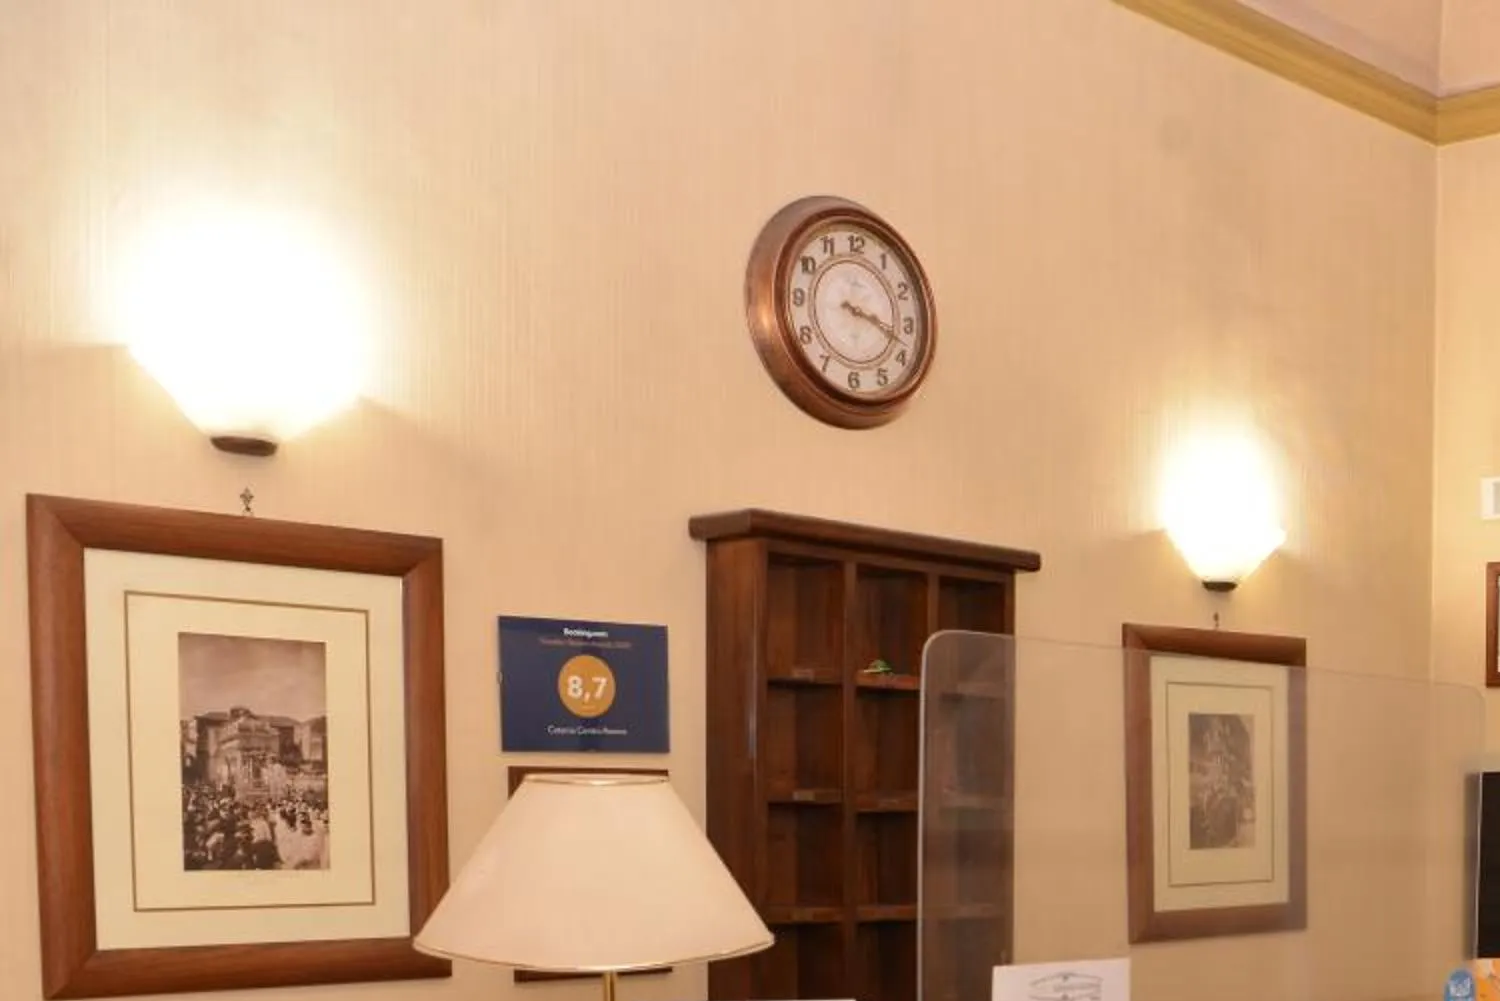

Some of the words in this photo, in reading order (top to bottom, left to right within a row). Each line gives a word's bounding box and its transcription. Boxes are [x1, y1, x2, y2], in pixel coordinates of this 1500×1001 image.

[820, 236, 835, 256] 11
[848, 235, 866, 254] 12
[801, 256, 817, 275] 10
[880, 254, 888, 269] 1
[792, 287, 806, 306] 9
[897, 282, 909, 300] 2
[800, 326, 813, 344] 8
[904, 317, 914, 335] 3
[819, 354, 831, 372] 7
[896, 351, 906, 367] 4
[848, 372, 860, 389] 6
[877, 368, 889, 386] 5
[567, 675, 608, 704] 8,7
